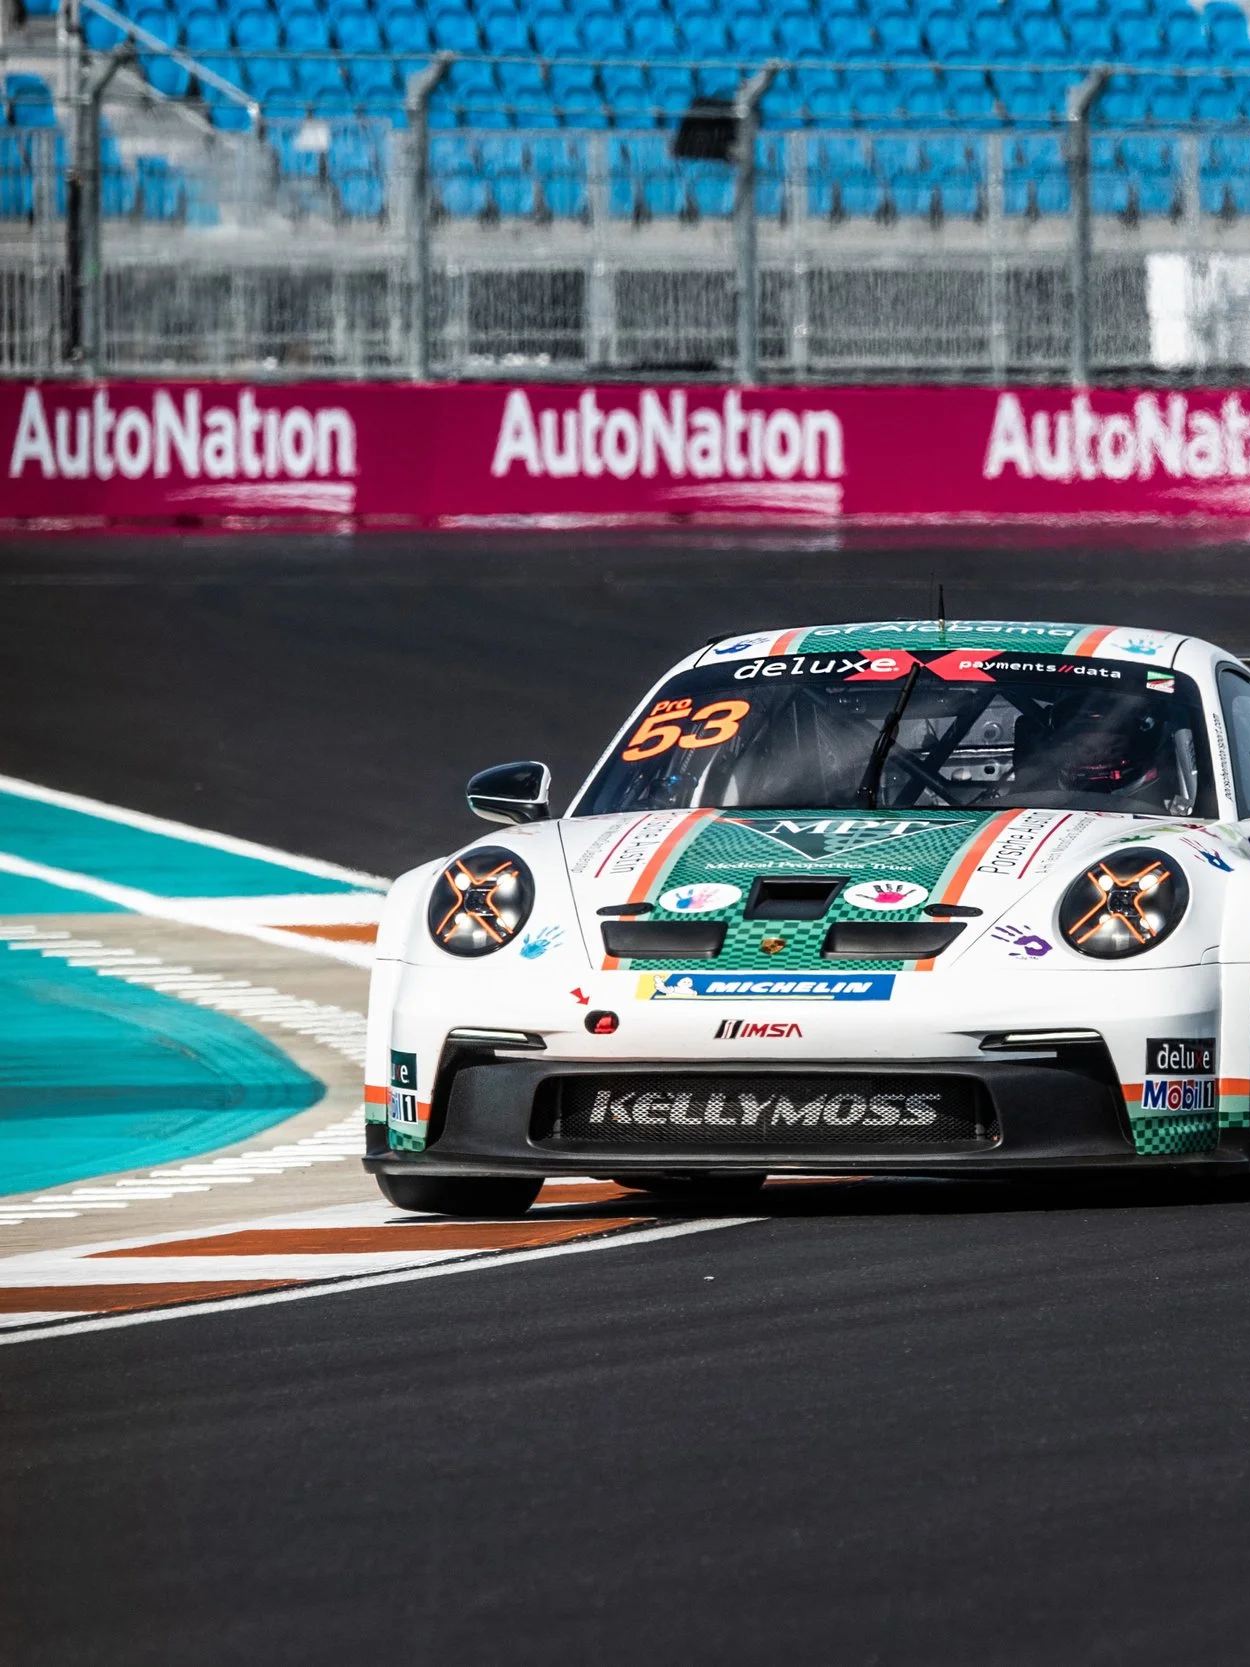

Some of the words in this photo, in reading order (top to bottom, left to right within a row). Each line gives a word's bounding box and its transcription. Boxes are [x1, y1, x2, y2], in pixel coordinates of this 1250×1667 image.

[10, 387, 357, 480] AutoNation
[491, 388, 843, 480] AutoNation
[869, 624, 1075, 637] Alabama
[734, 655, 899, 681] deluxe
[650, 698, 693, 717] Pro
[622, 700, 750, 762] 53
[767, 820, 931, 835] MPT
[704, 861, 773, 870] Medical
[777, 861, 867, 870] Properties
[869, 863, 915, 873] Trust
[977, 834, 1035, 875] Porsche
[705, 981, 873, 994] MICHELIN
[740, 1023, 803, 1038] IMSA
[1157, 1043, 1210, 1070] deluxe
[589, 1090, 942, 1126] KELLYMOSS
[1141, 1079, 1203, 1112] Mobil
